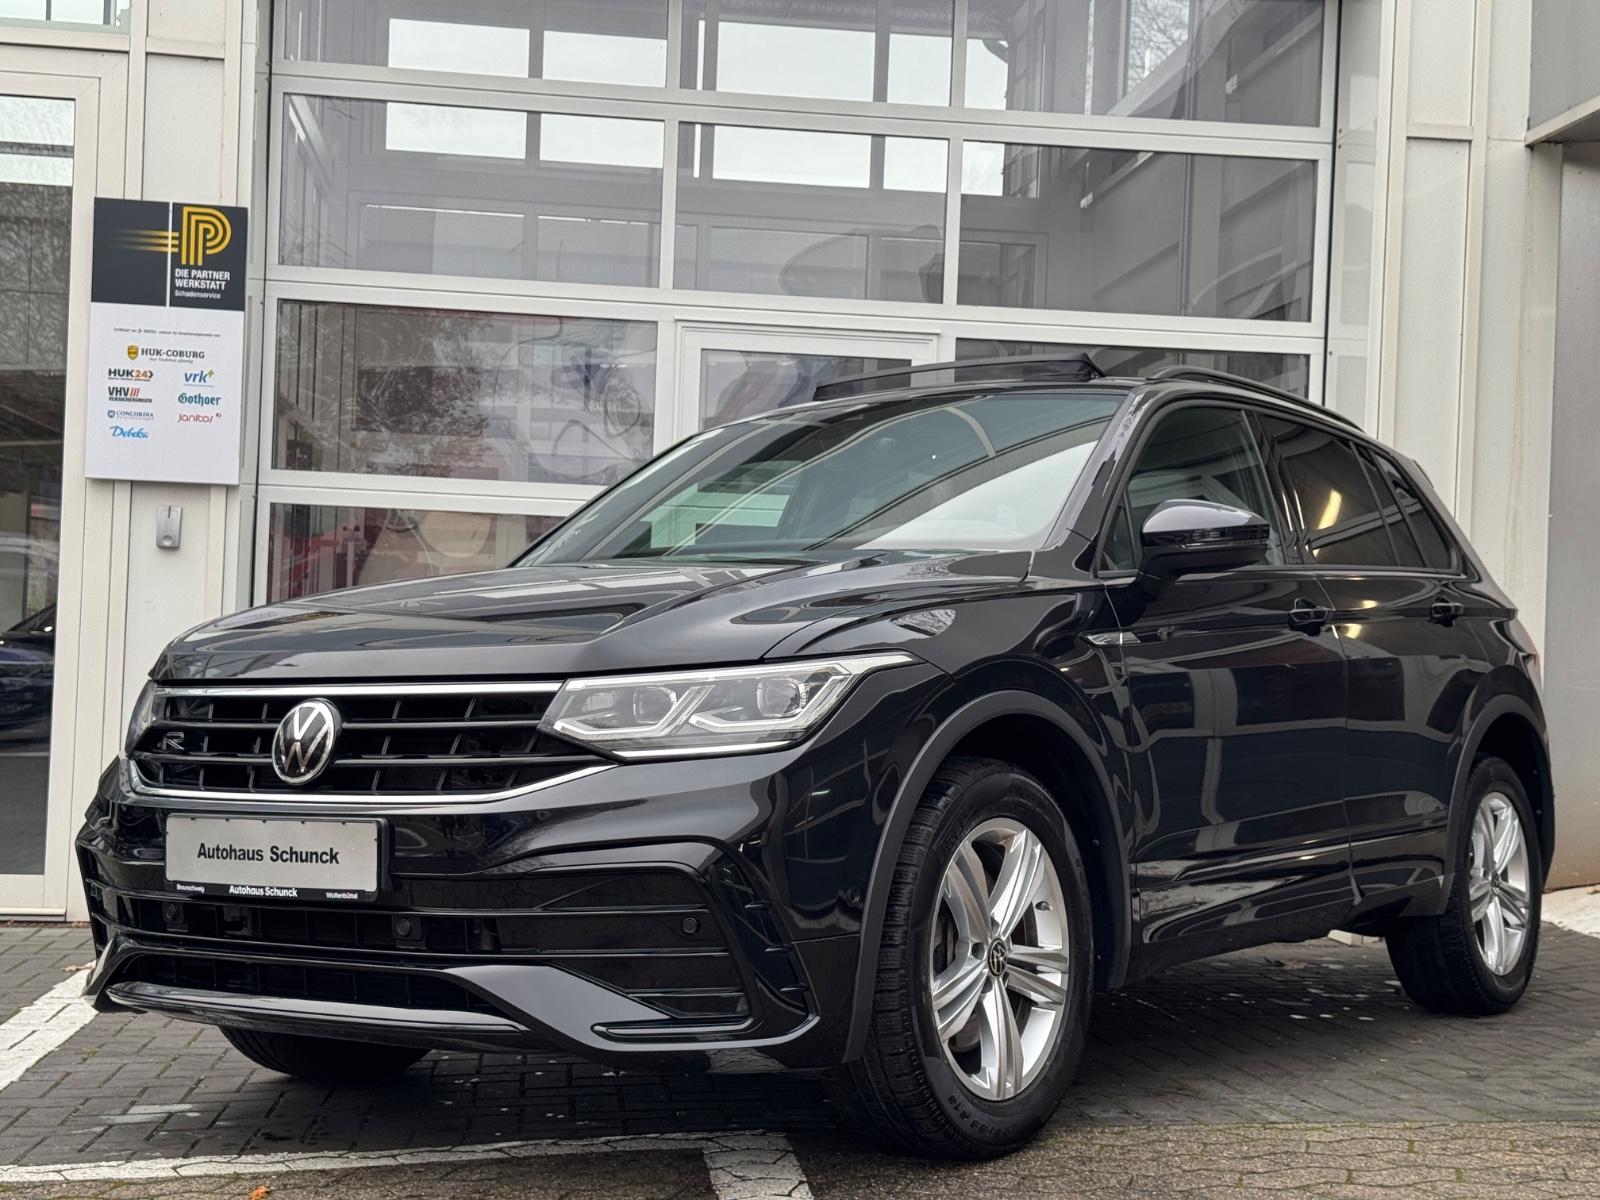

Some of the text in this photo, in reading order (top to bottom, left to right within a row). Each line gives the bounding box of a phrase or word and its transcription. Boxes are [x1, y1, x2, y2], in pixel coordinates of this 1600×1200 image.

[175, 268, 231, 281] DIE PARTNER
[174, 279, 227, 290] WERKSTATT
[174, 290, 221, 299] Schadenservice
[141, 348, 206, 359] HUK-COBURG
[177, 393, 222, 407] Gothaer
[116, 409, 155, 418] CONCORDIA
[197, 842, 340, 865] Autohaus Schunck
[228, 884, 299, 898] Autohaus Schunck
